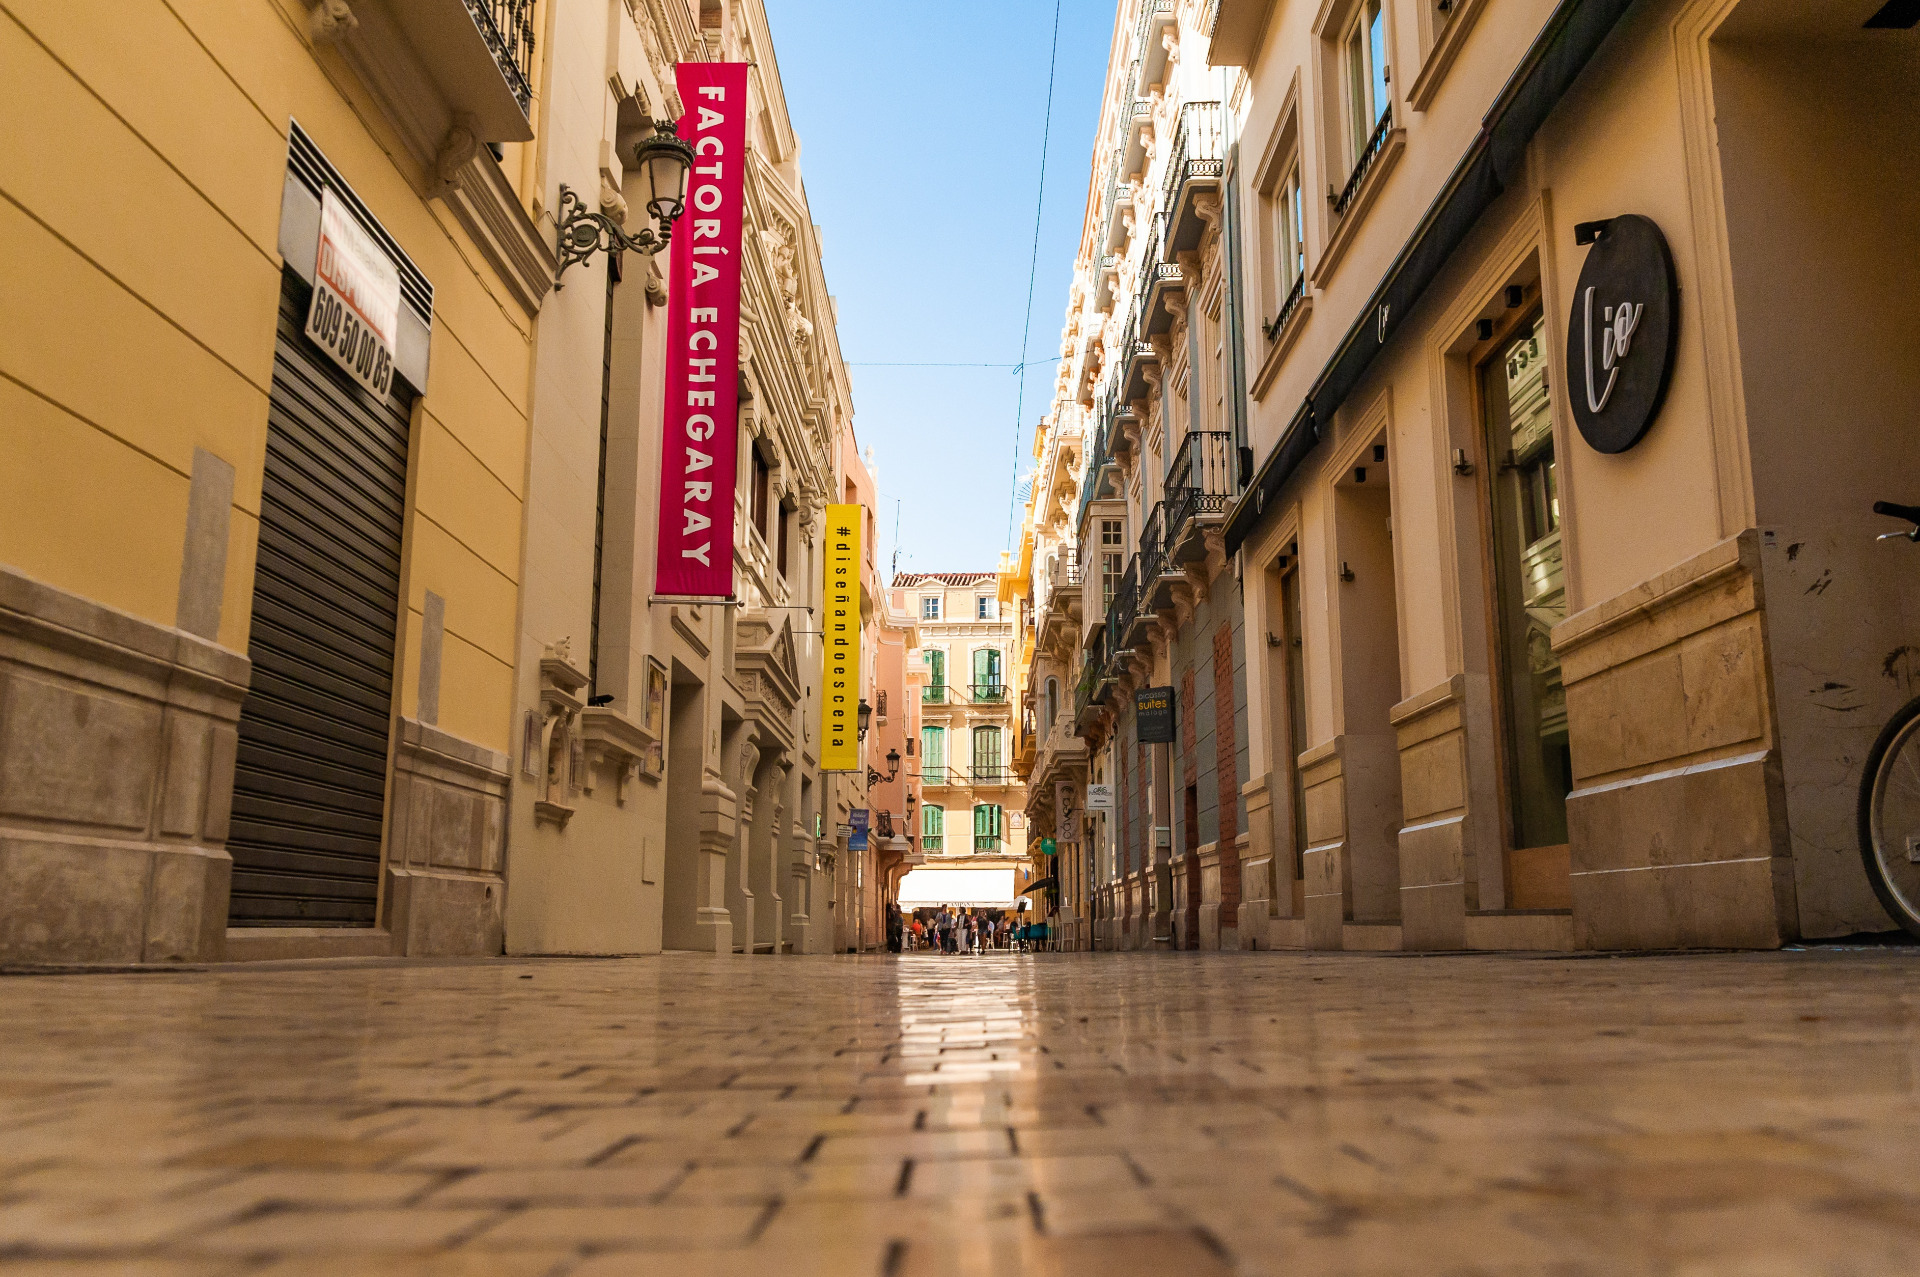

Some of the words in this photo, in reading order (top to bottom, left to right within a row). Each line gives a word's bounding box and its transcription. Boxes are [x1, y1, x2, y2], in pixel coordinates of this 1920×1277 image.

[691, 86, 729, 288] FACTORÍA
[313, 285, 342, 349] 609
[338, 311, 360, 365] 50
[355, 329, 376, 381] 00
[372, 345, 392, 395] 85
[681, 307, 718, 568] ECHEGARAY
[832, 526, 851, 747] #diseñandoescena
[1138, 699, 1167, 711] suites
